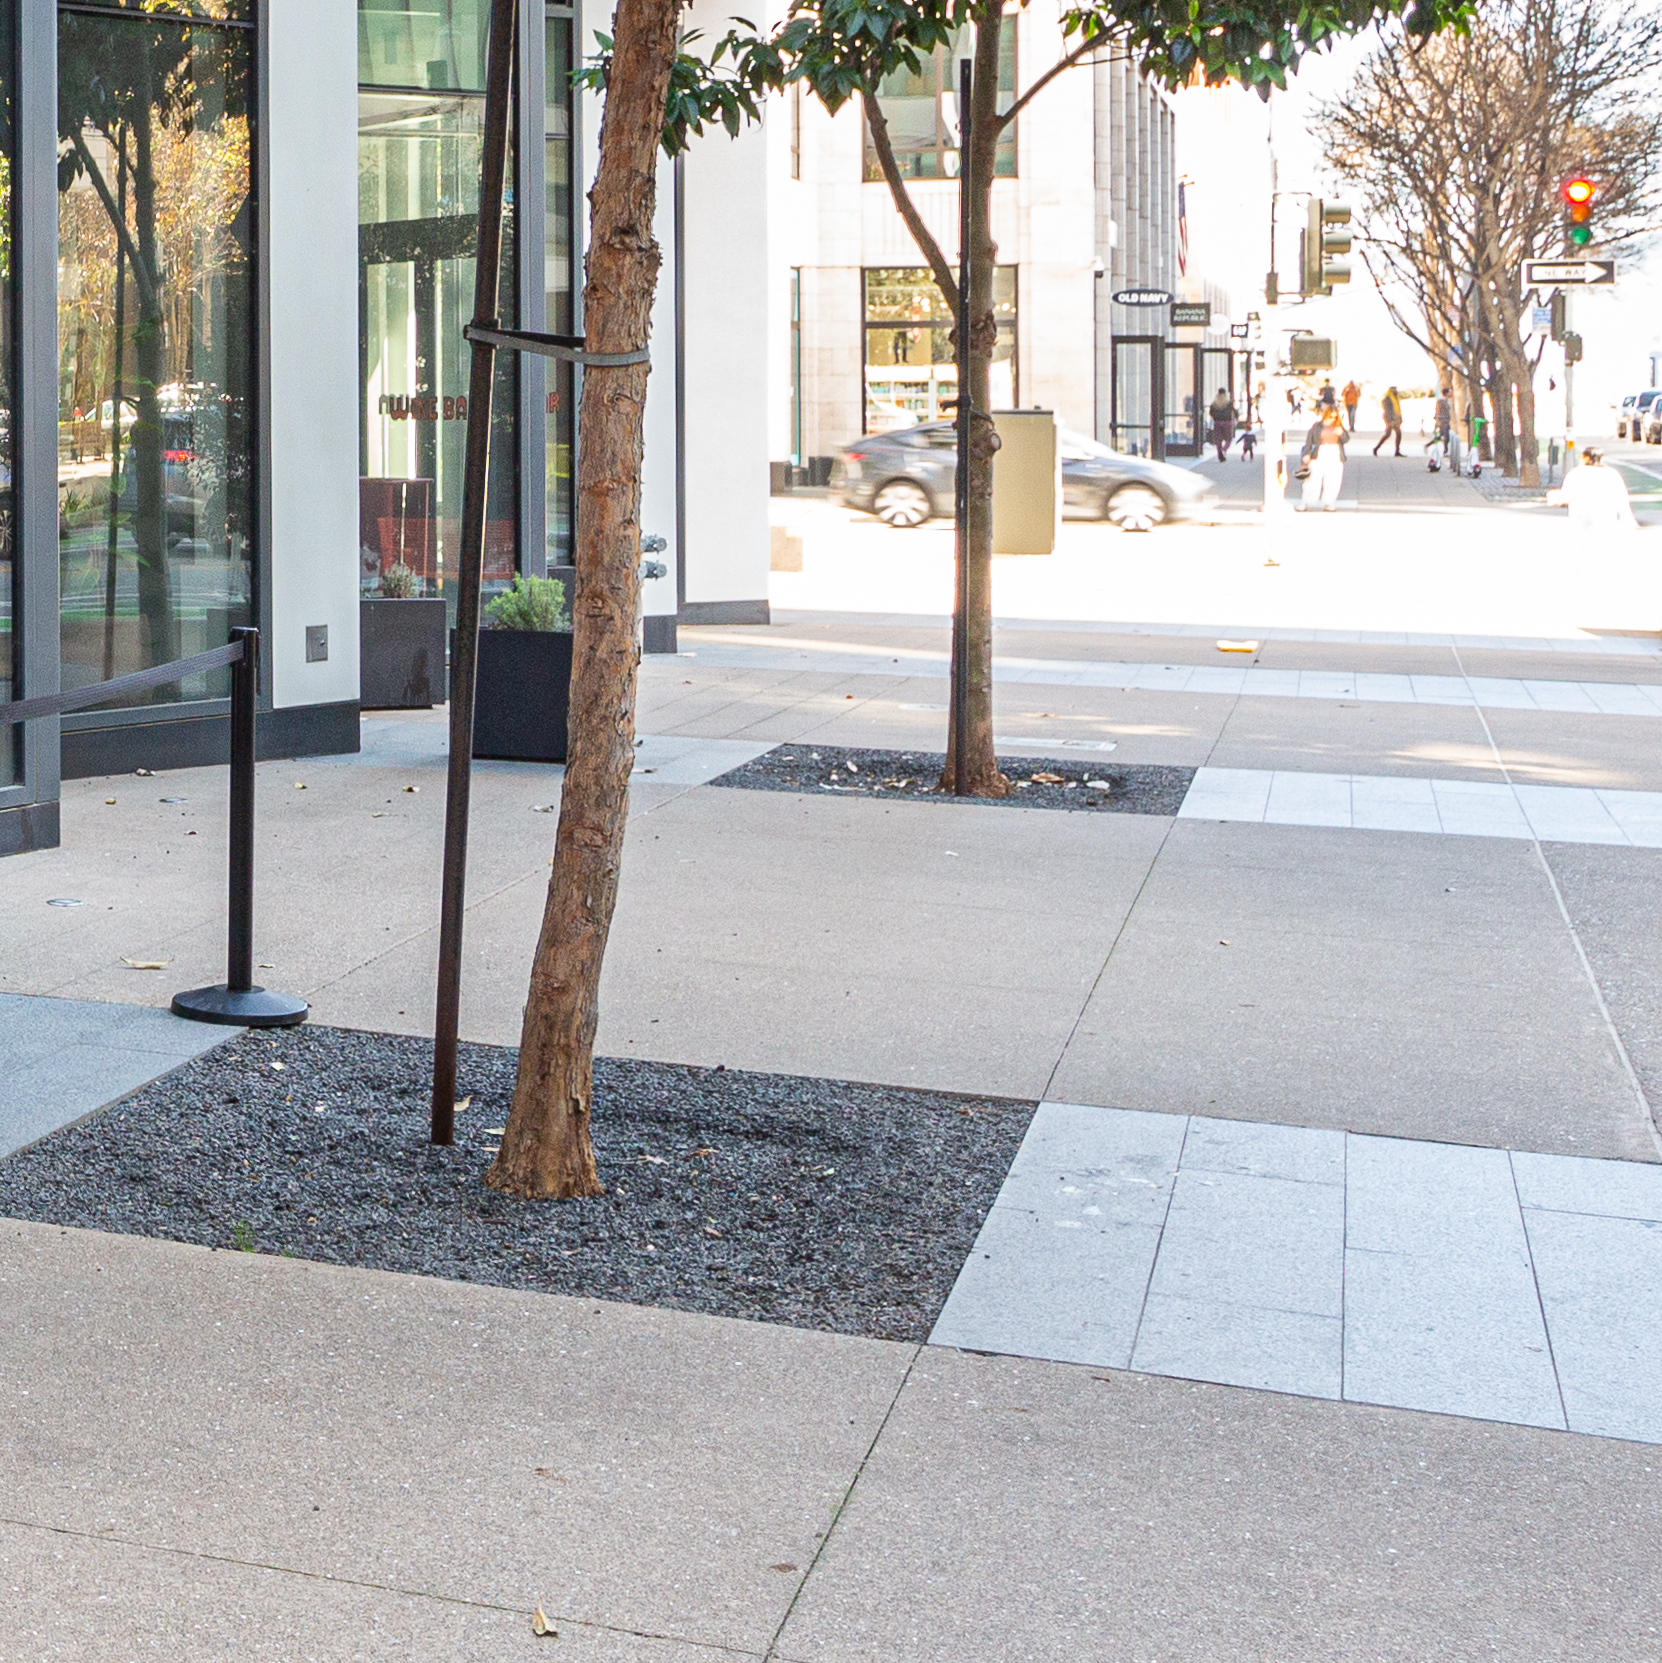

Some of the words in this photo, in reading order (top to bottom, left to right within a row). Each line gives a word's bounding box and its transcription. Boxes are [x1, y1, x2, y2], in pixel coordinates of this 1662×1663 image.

[1117, 293, 1139, 303] OLD
[1140, 293, 1169, 303] NAVY
[443, 395, 468, 421] BA
